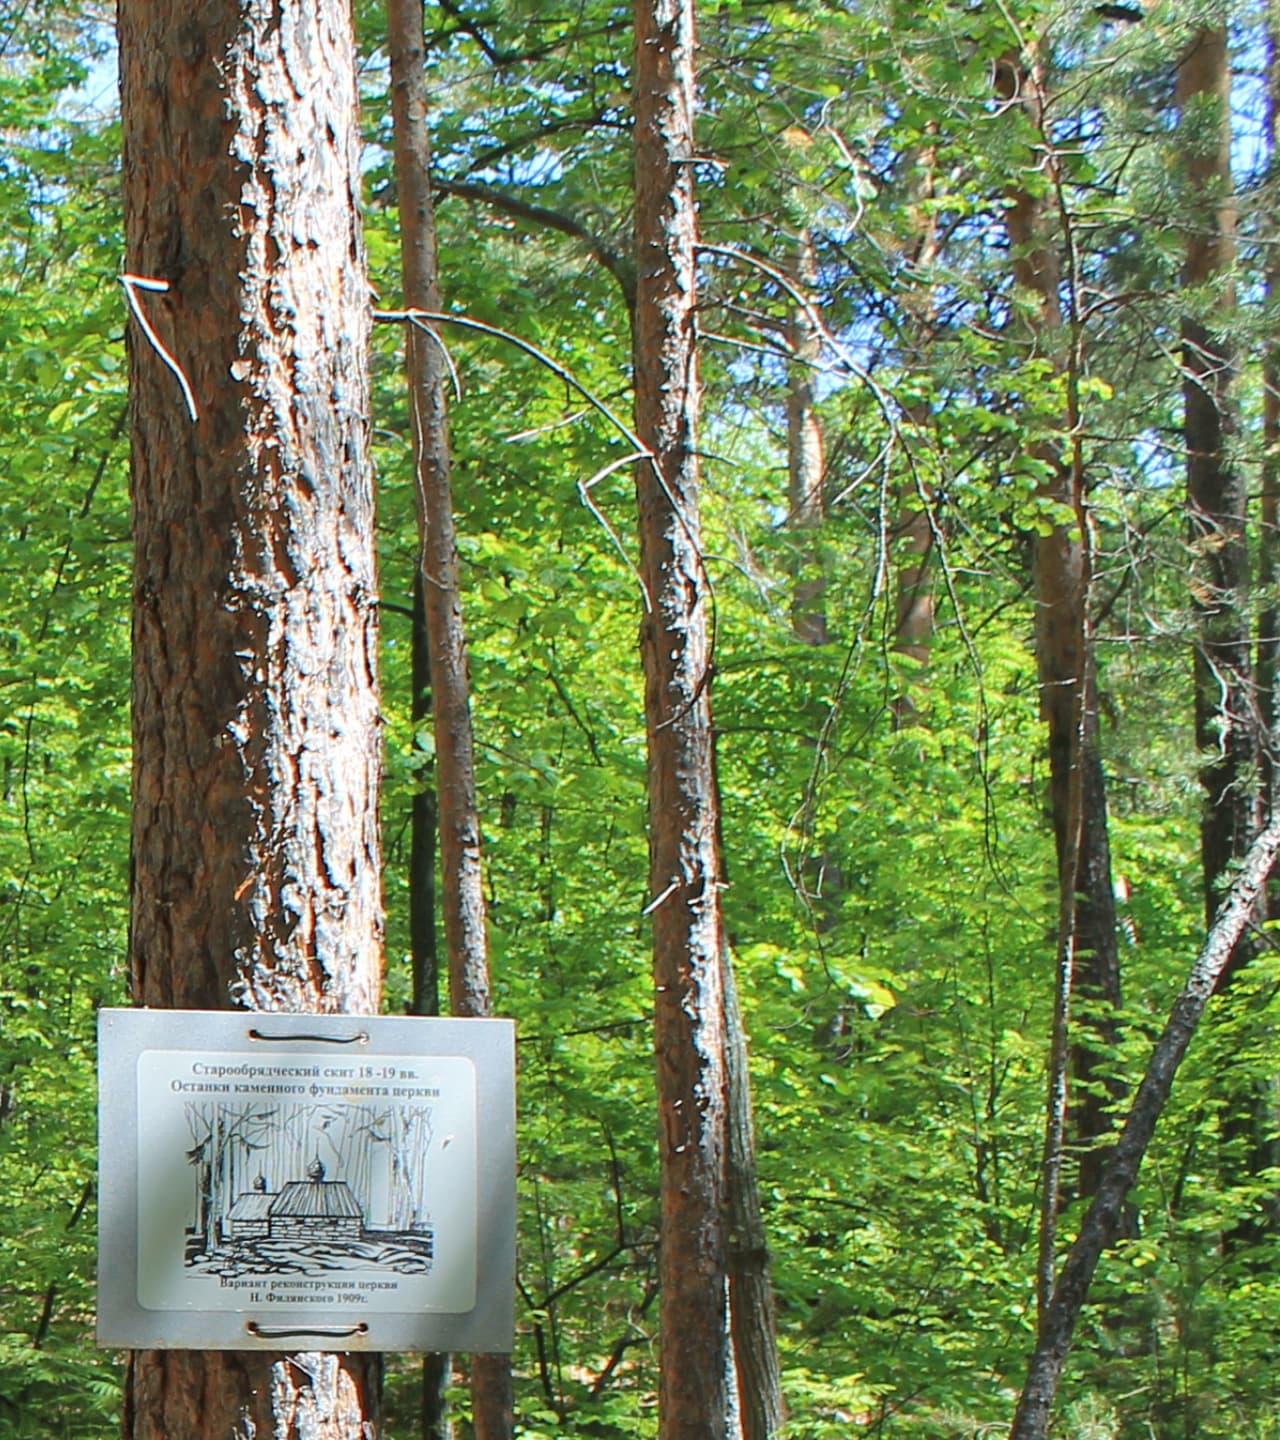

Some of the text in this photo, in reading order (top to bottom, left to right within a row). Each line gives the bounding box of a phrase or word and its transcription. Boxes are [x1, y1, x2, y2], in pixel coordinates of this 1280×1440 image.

[323, 1067, 355, 1078] скит
[359, 1066, 373, 1078] 18
[171, 1080, 440, 1099] Останки каменного фундамента церкви
[220, 1278, 267, 1290] Вариант
[358, 1281, 398, 1291] церкви
